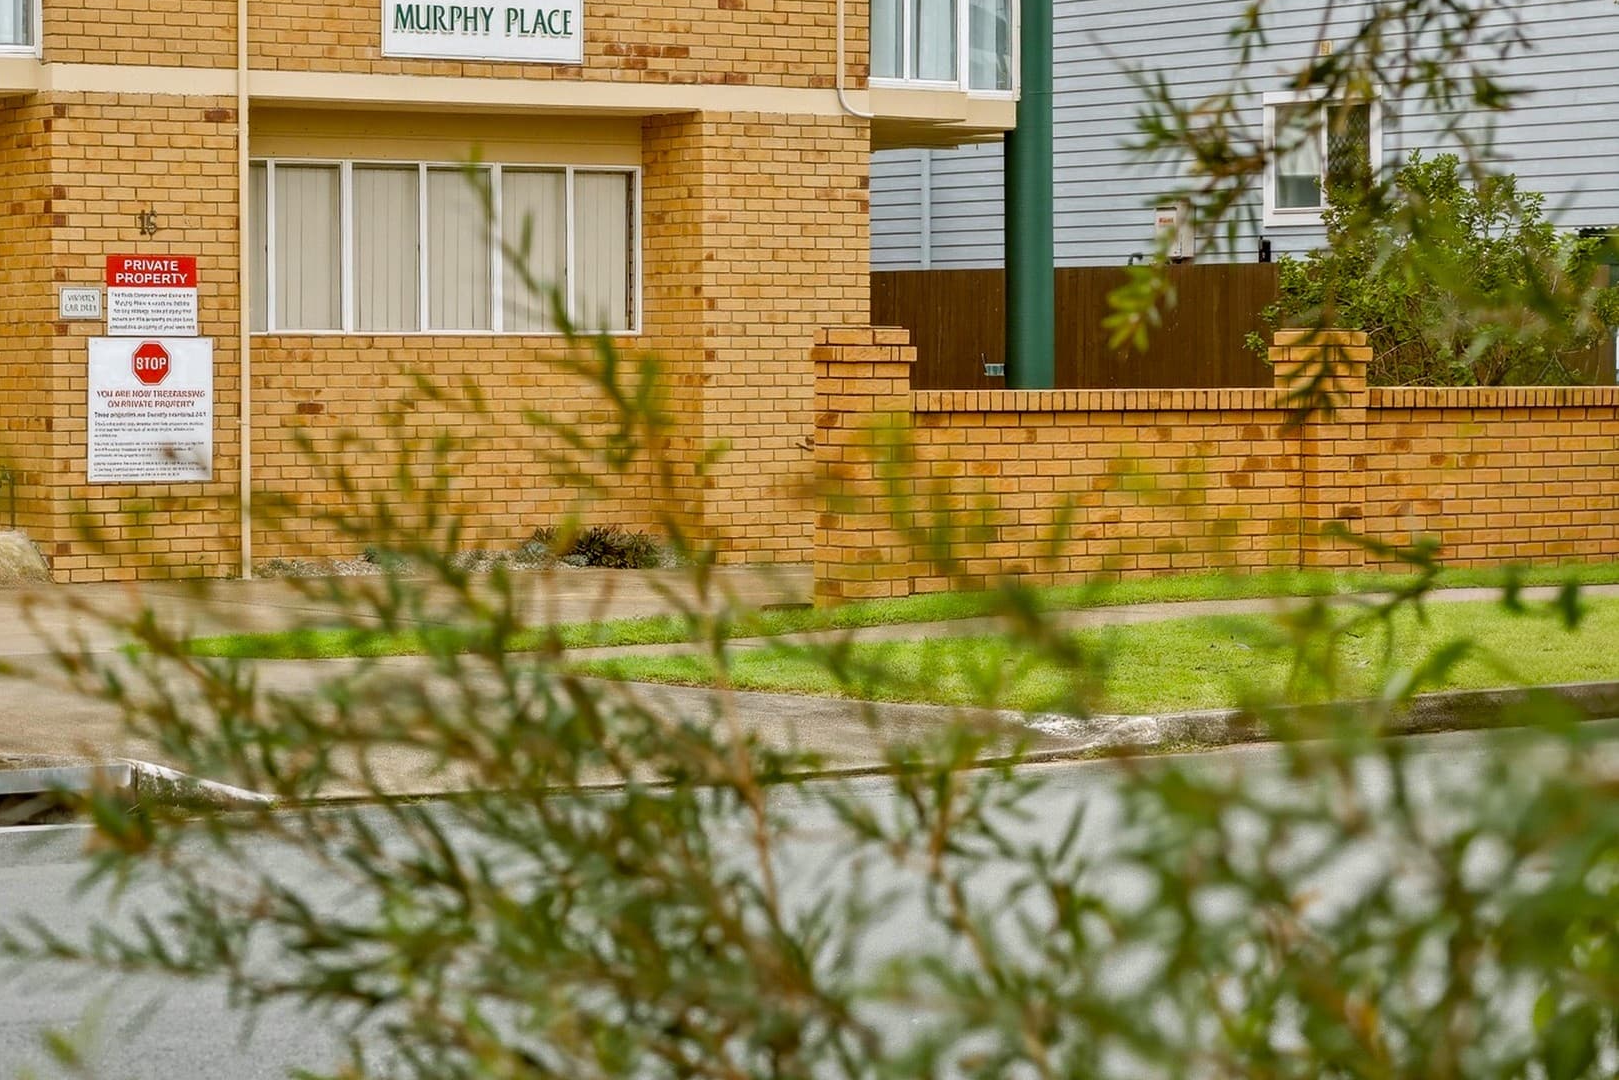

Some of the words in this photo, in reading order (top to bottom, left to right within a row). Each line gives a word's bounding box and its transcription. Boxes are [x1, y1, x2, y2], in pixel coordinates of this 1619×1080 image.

[394, 3, 494, 32] MURPHY
[506, 7, 573, 36] PLACE
[124, 259, 179, 271] PRIVATE
[115, 272, 188, 284] PROPERTY
[136, 357, 167, 370] STOP
[96, 390, 113, 398] YOU
[115, 390, 131, 398] ARE
[132, 390, 151, 398] NOW
[107, 400, 120, 408] ON
[120, 400, 153, 408] PRIVATE
[155, 400, 195, 408] PROPERTY
